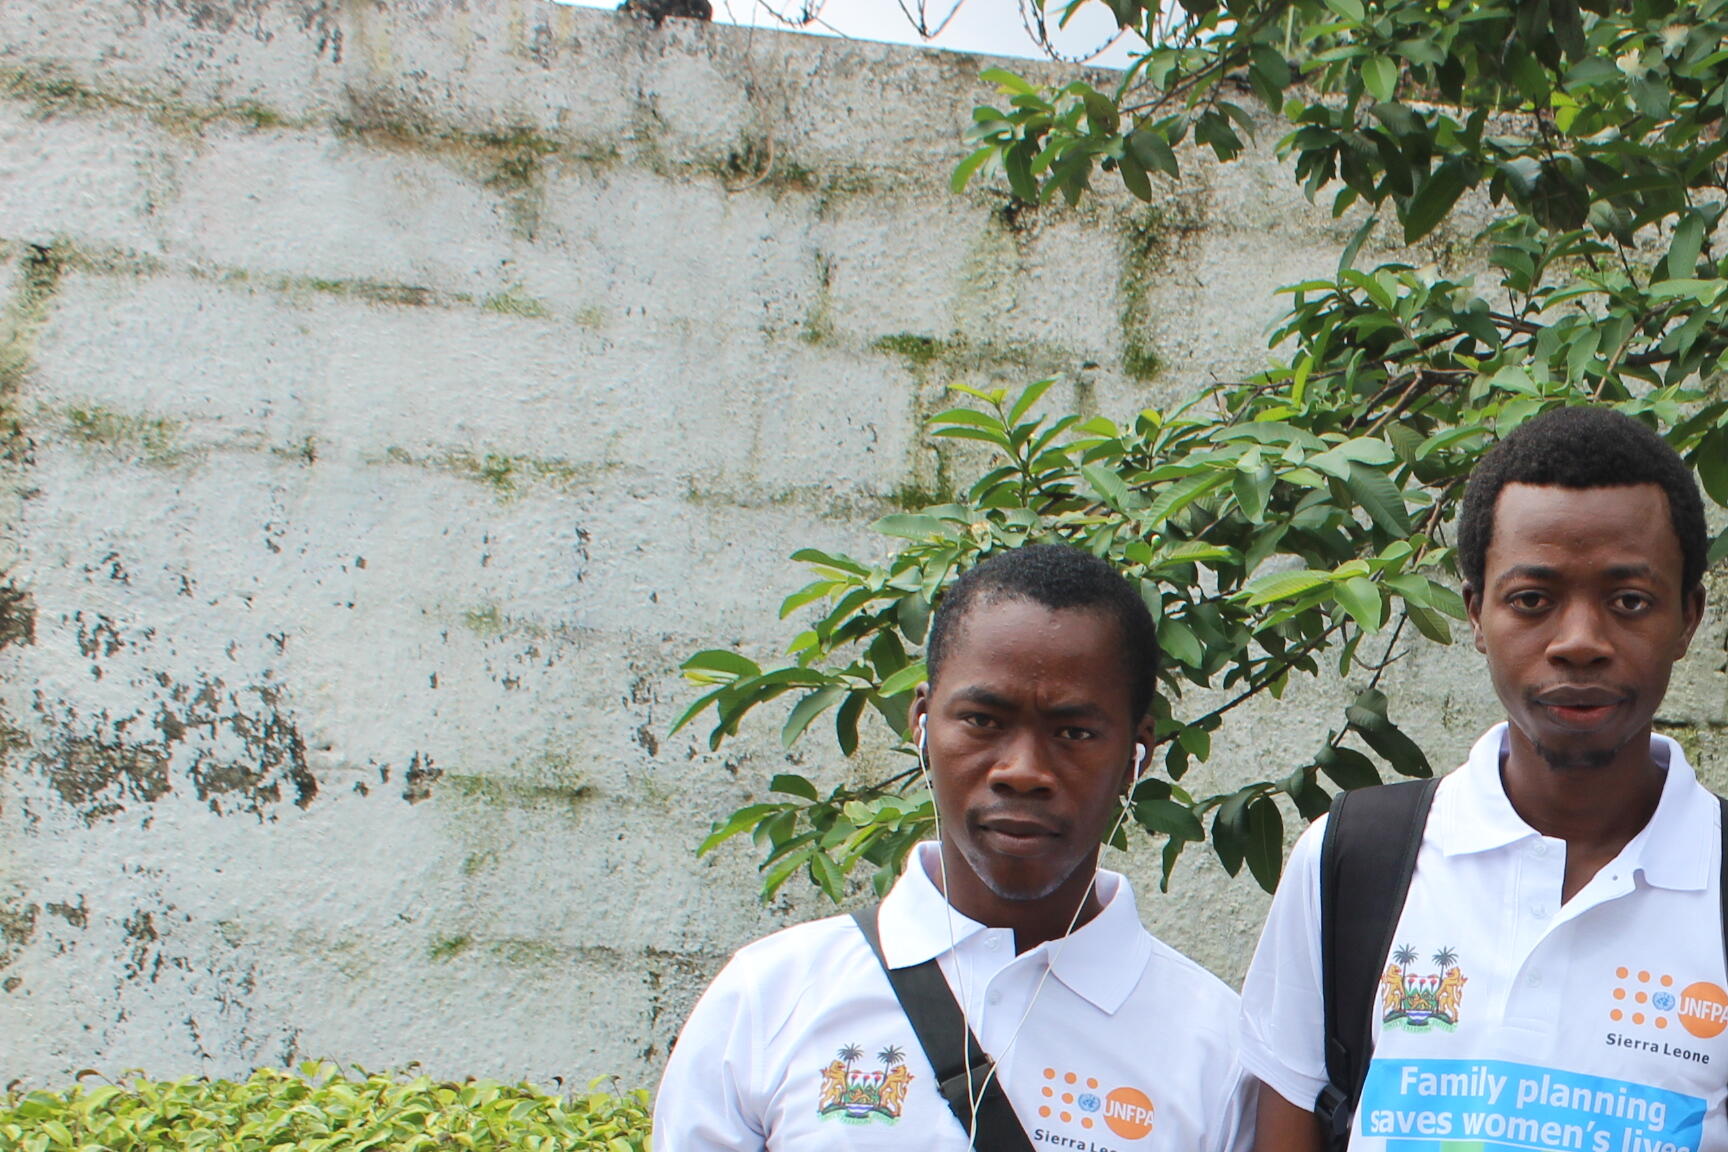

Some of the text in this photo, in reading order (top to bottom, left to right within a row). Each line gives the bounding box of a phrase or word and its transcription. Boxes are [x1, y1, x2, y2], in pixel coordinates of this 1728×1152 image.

[1605, 1032, 1710, 1064] Sierra Leone
[1103, 1098, 1154, 1127] UNFPA
[1400, 1066, 1667, 1132] Family planning
[1033, 1128, 1086, 1151] Sierra
[1370, 1109, 1452, 1134] saves
[1463, 1111, 1611, 1152] women's
